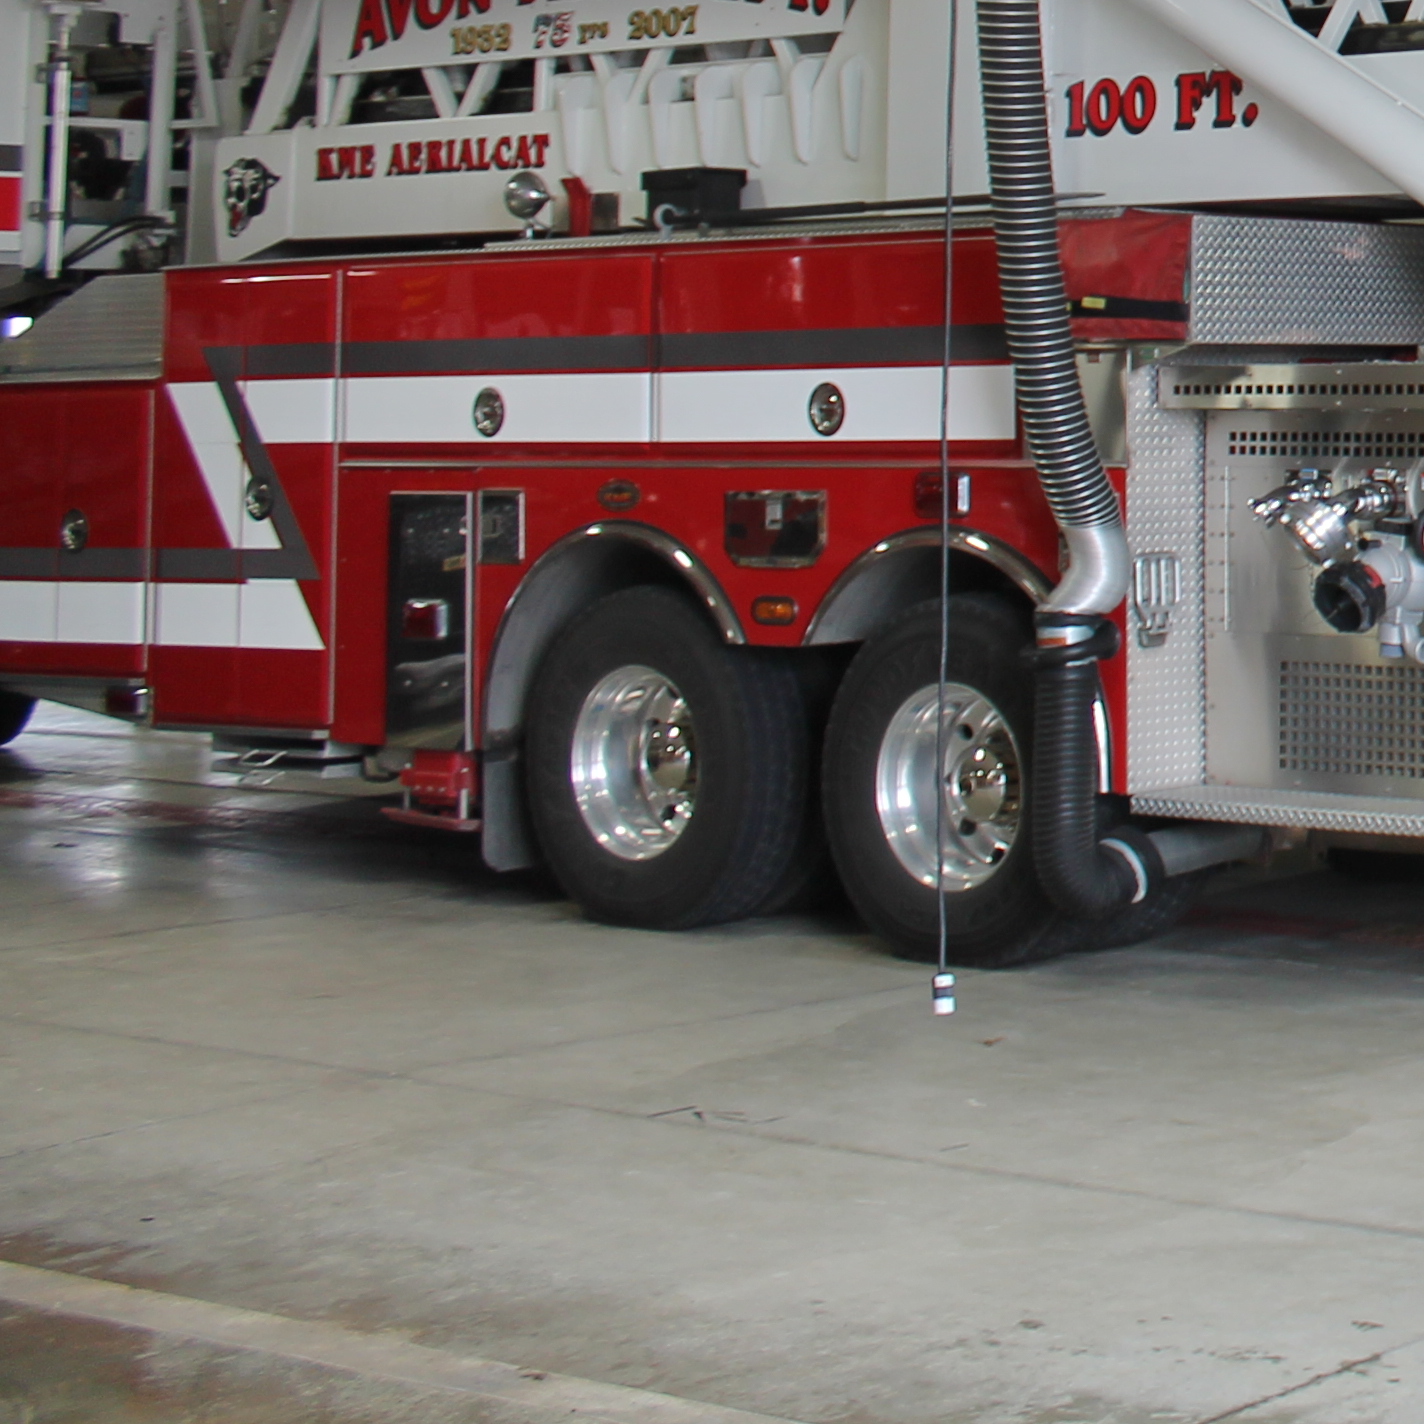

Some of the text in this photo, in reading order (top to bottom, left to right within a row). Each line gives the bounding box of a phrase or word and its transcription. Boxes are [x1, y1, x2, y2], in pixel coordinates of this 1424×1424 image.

[450, 23, 512, 56] 1932
[533, 10, 574, 49] 75
[627, 4, 699, 41] 2007
[1065, 70, 1259, 137] 100 FT.
[315, 133, 550, 181] KME AERIALCAT
